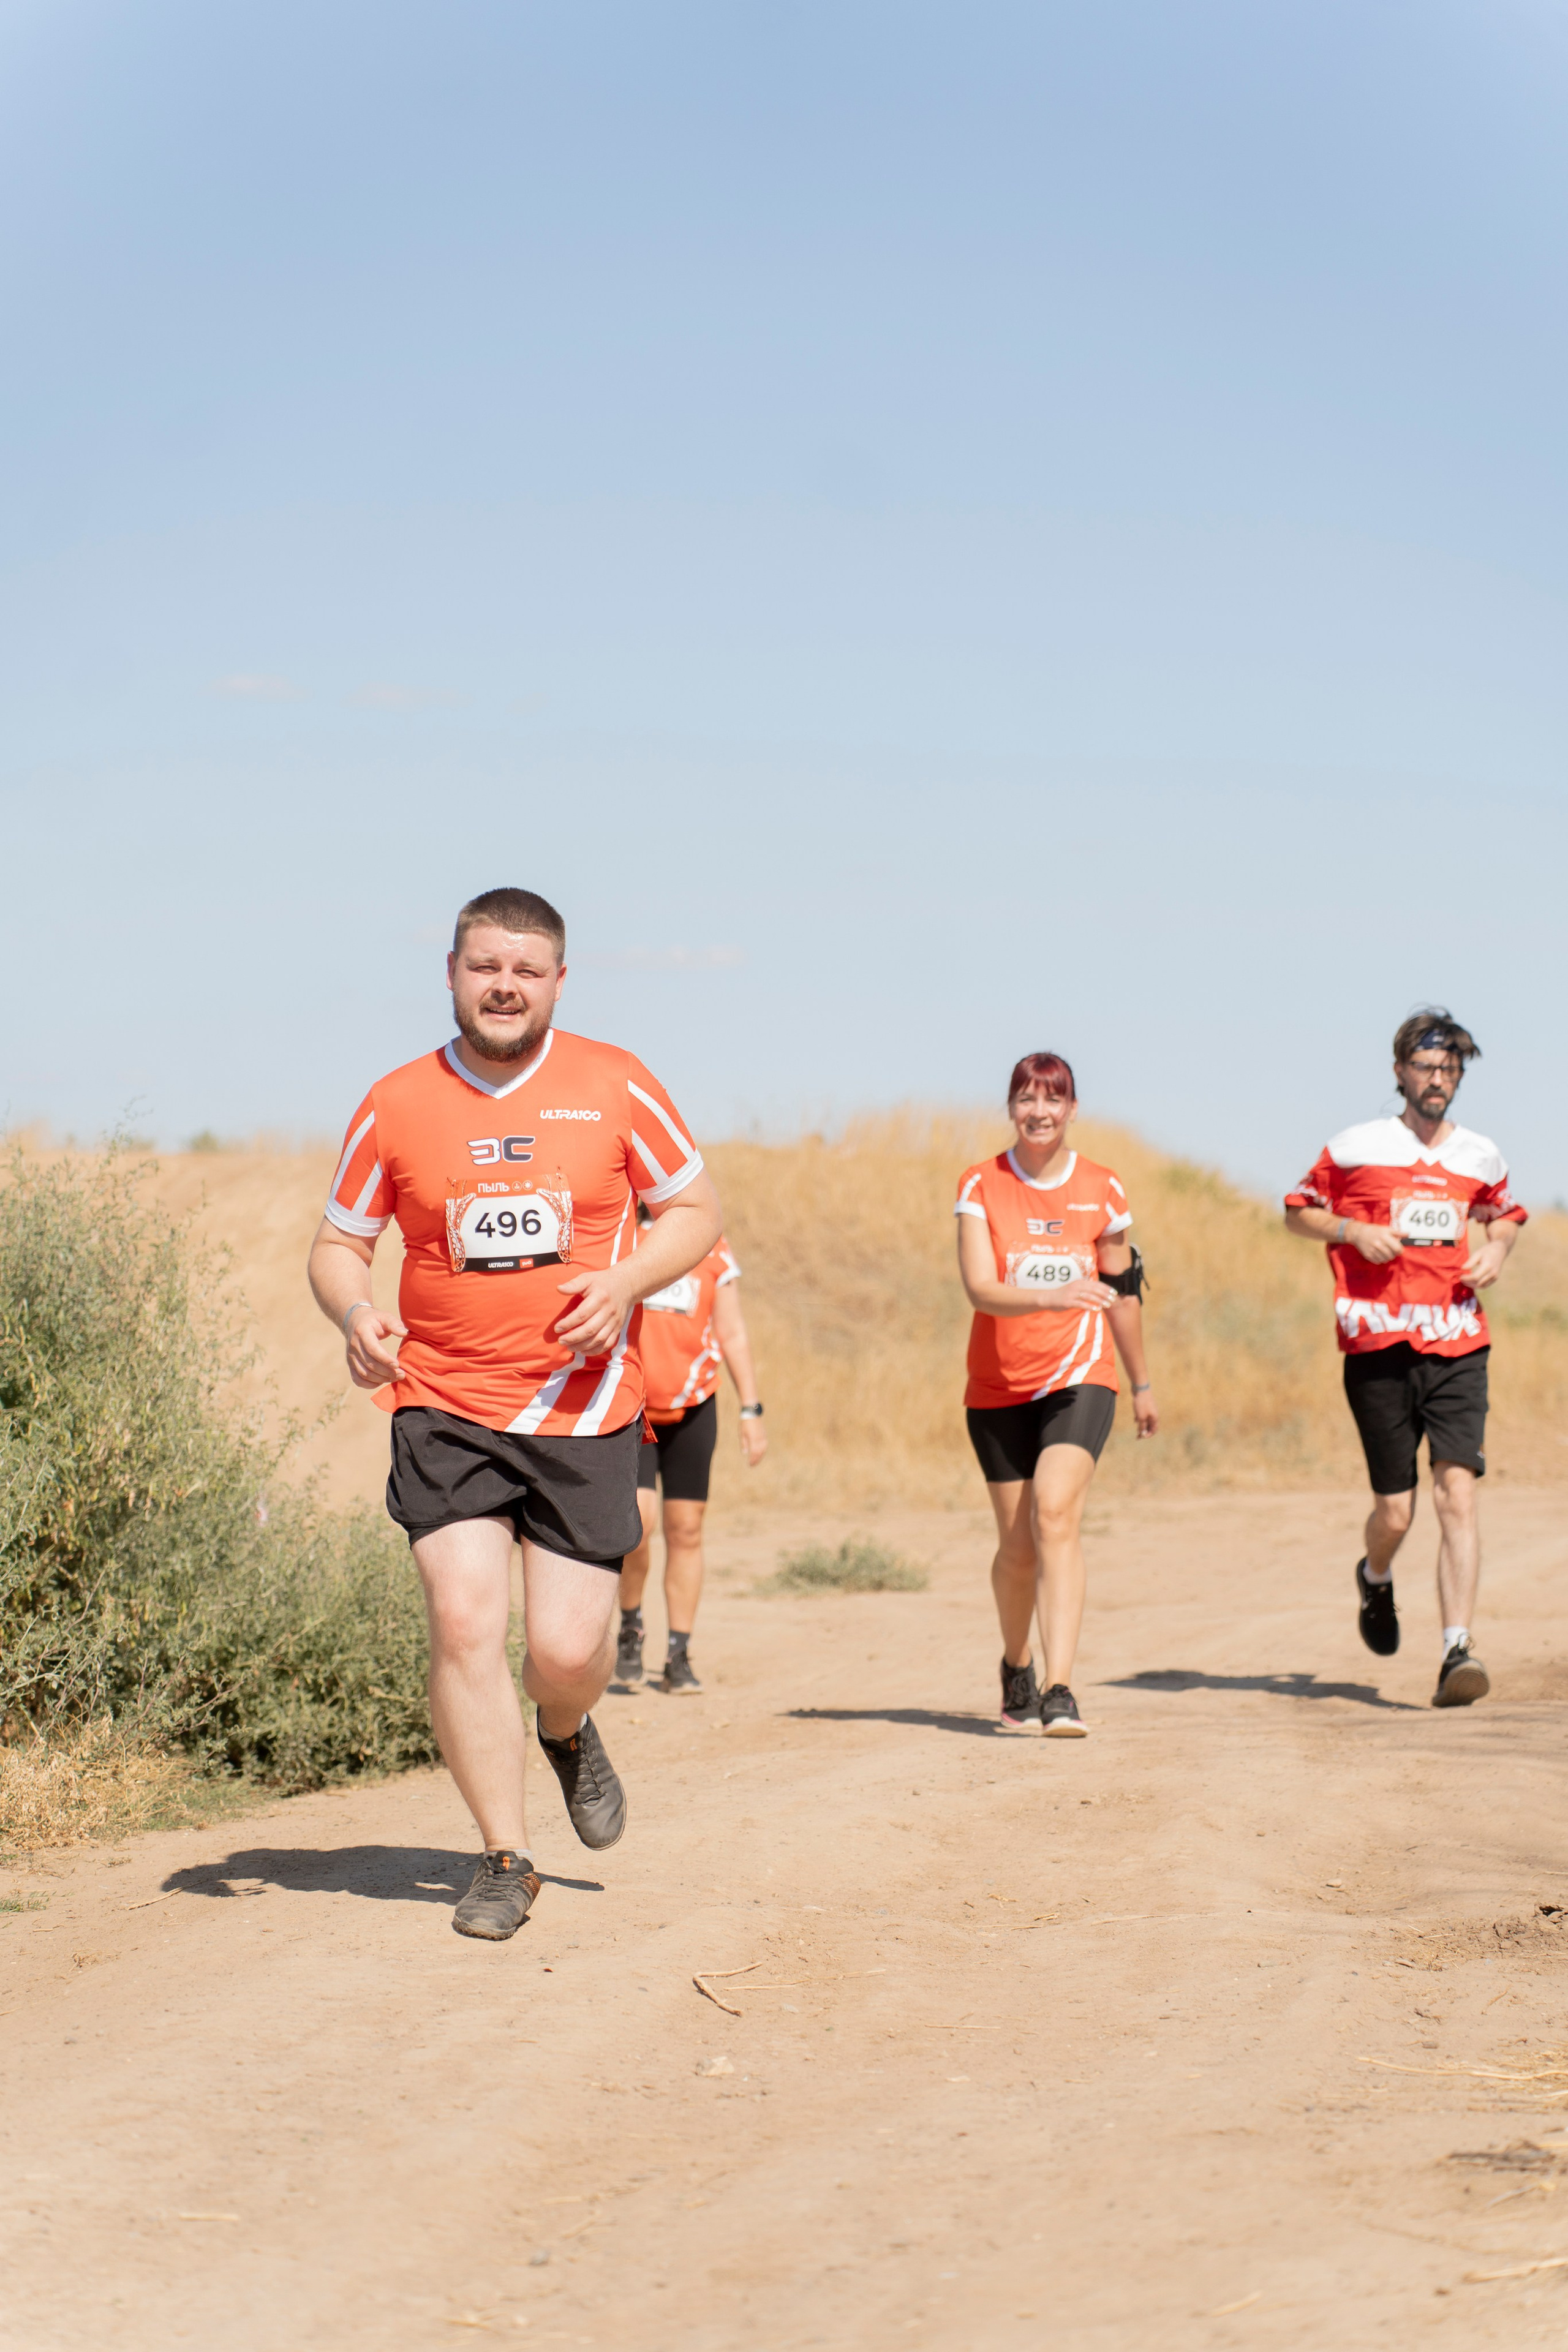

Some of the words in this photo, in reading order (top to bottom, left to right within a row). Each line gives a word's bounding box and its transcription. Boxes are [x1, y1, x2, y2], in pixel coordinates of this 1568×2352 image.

[540, 1109, 601, 1121] ULTRA100
[478, 1182, 510, 1193] ПЫЛЬ
[475, 1209, 541, 1238] 496
[1409, 1208, 1450, 1227] 460
[1027, 1264, 1071, 1283] 489
